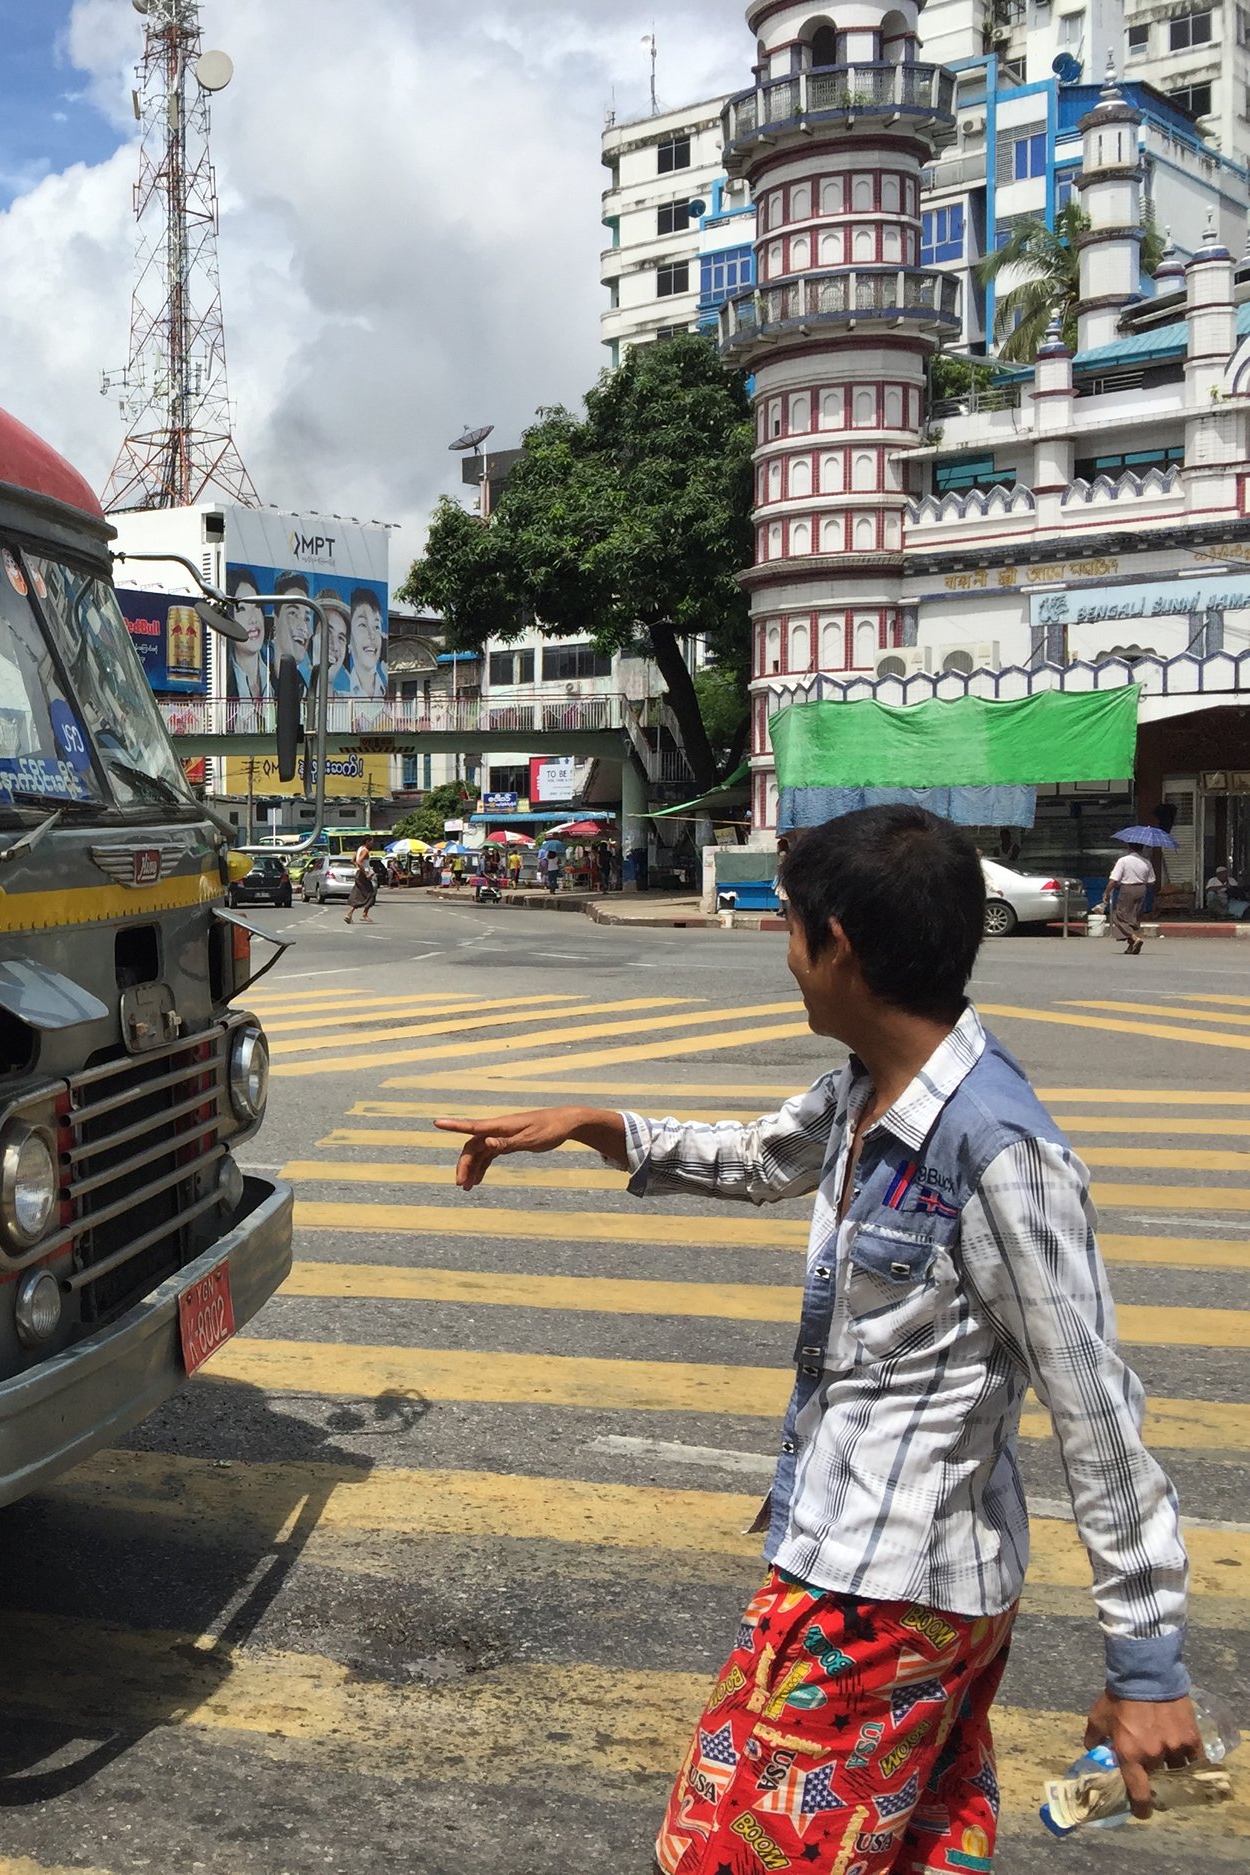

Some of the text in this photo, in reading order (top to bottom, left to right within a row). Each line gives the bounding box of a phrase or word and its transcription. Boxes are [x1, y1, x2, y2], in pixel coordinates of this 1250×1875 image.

[301, 534, 336, 557] MPT
[1077, 596, 1147, 619] BENGALI
[1150, 591, 1201, 614] SUNNI
[546, 770, 556, 779] TO
[196, 1275, 215, 1305] YGN
[901, 1606, 957, 1649] BOOM
[846, 1723, 883, 1768] USA
[688, 1764, 717, 1804] USA
[757, 1751, 797, 1790] USA
[730, 1813, 790, 1869] BOOM
[855, 1832, 895, 1853] USA
